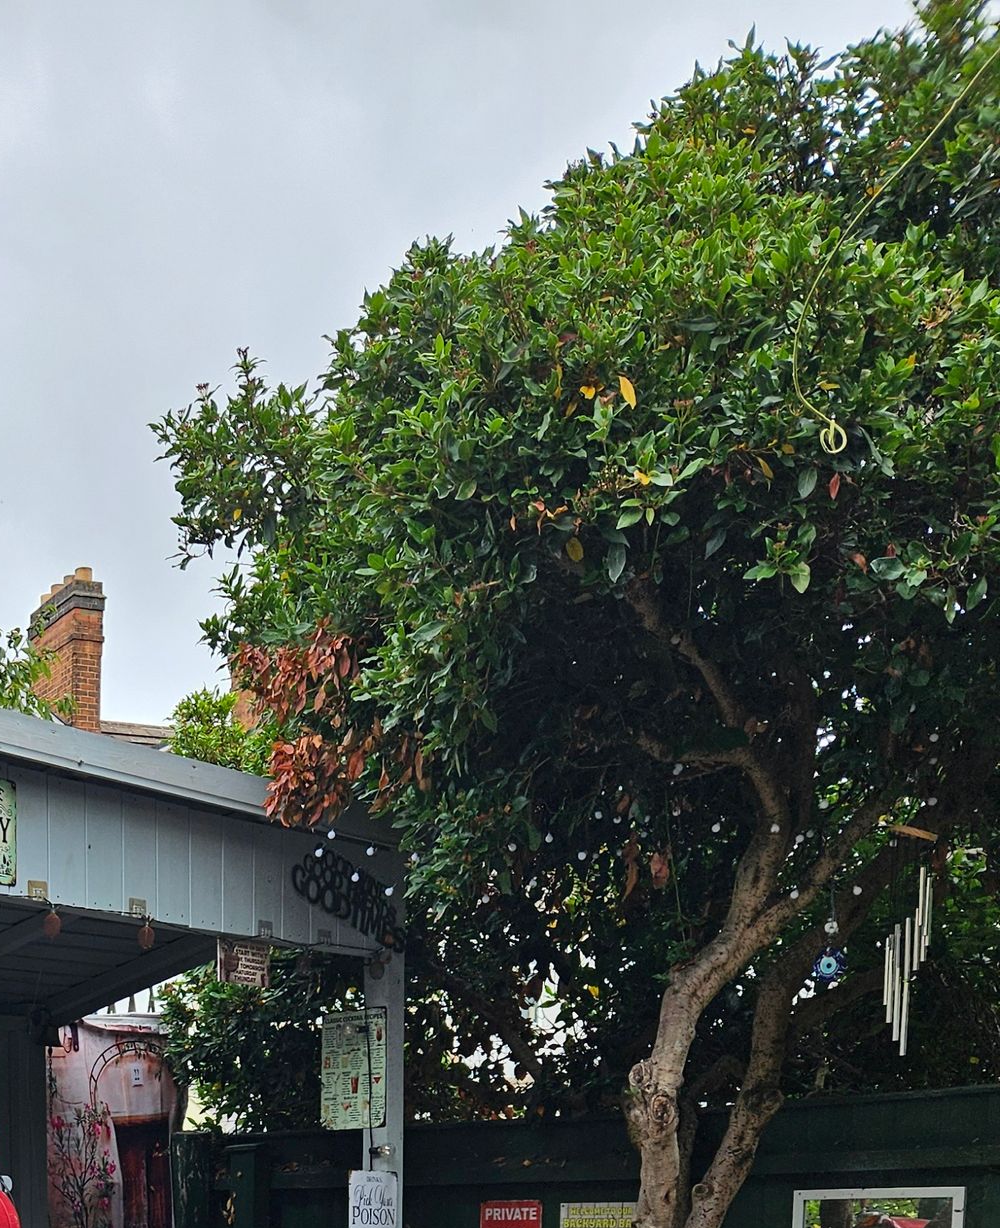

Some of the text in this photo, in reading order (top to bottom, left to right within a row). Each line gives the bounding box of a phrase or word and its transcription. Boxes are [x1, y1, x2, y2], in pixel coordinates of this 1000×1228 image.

[352, 1205, 395, 1225] POISON
[485, 1207, 537, 1221] PRIVATE
[563, 1218, 632, 1228] BACKYARD BA
